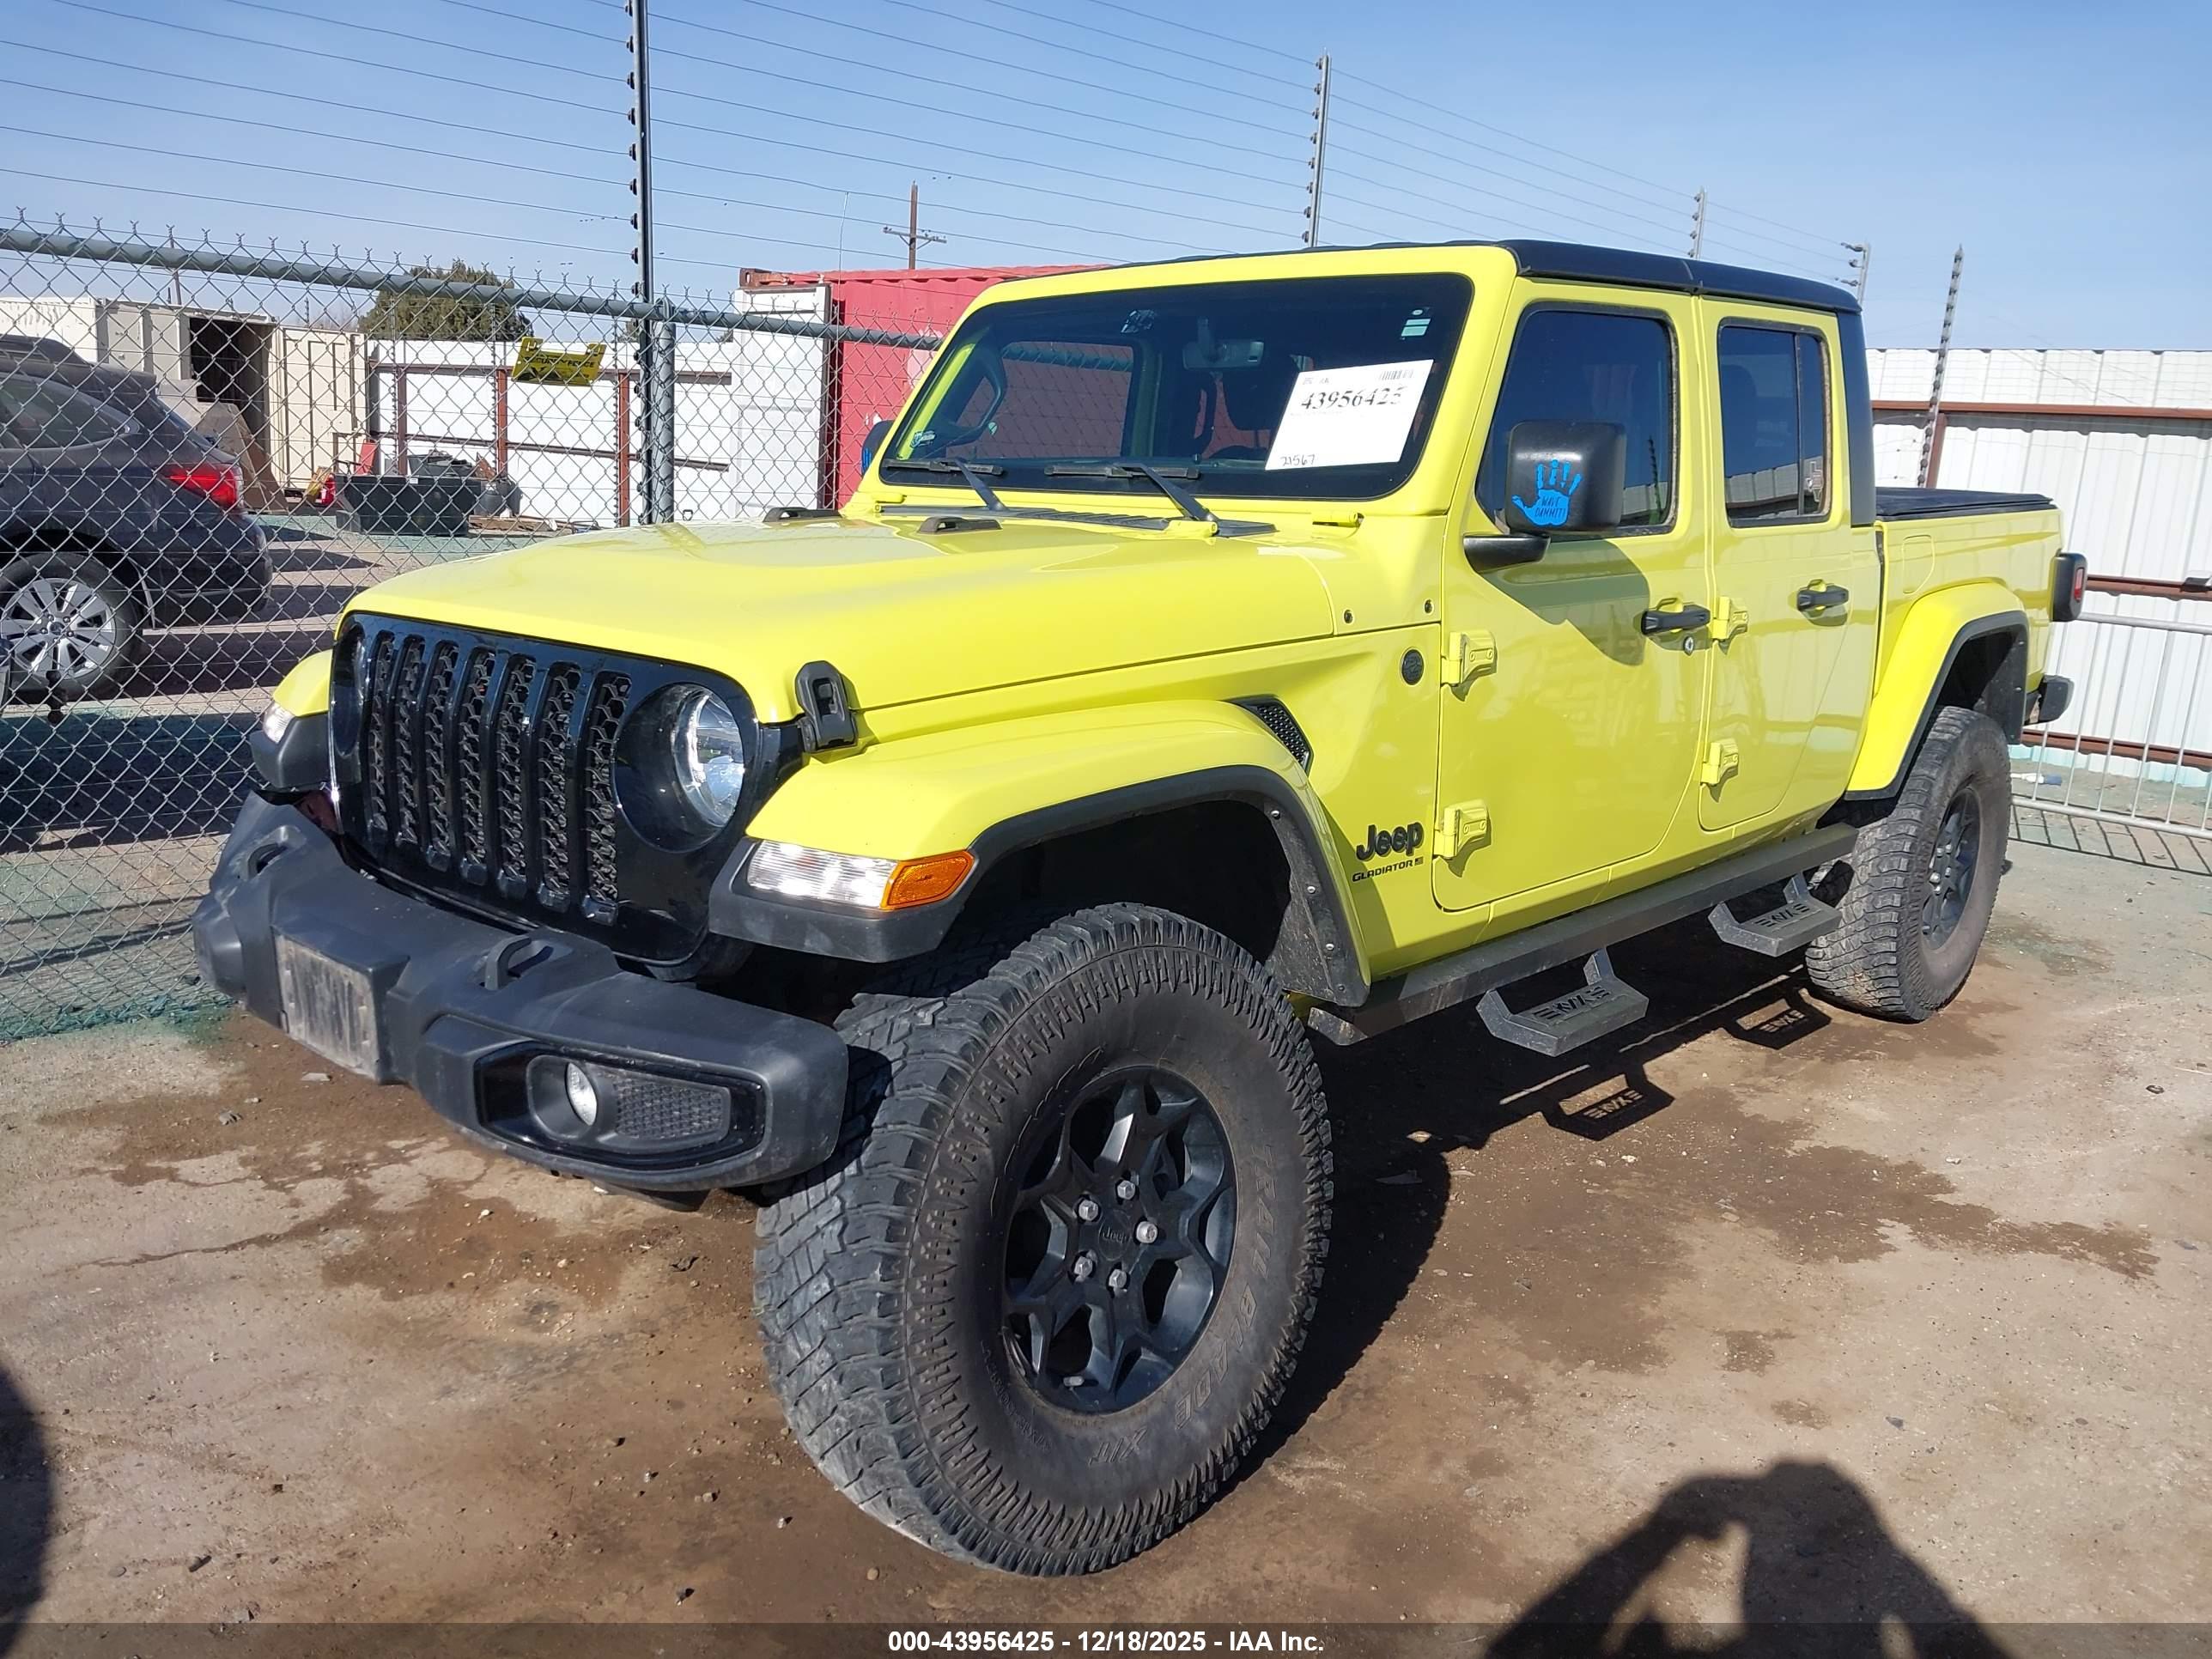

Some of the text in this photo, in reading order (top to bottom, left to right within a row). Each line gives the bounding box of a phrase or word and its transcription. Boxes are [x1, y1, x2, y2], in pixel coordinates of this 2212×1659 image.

[1301, 386, 1407, 410] 43956425
[1280, 454, 1315, 467] 21567
[1541, 496, 1559, 507] WAVE
[1356, 822, 1424, 861] Jeep
[1352, 860, 1413, 882] GLADIATOR
[1102, 1226, 1127, 1244] Jeep
